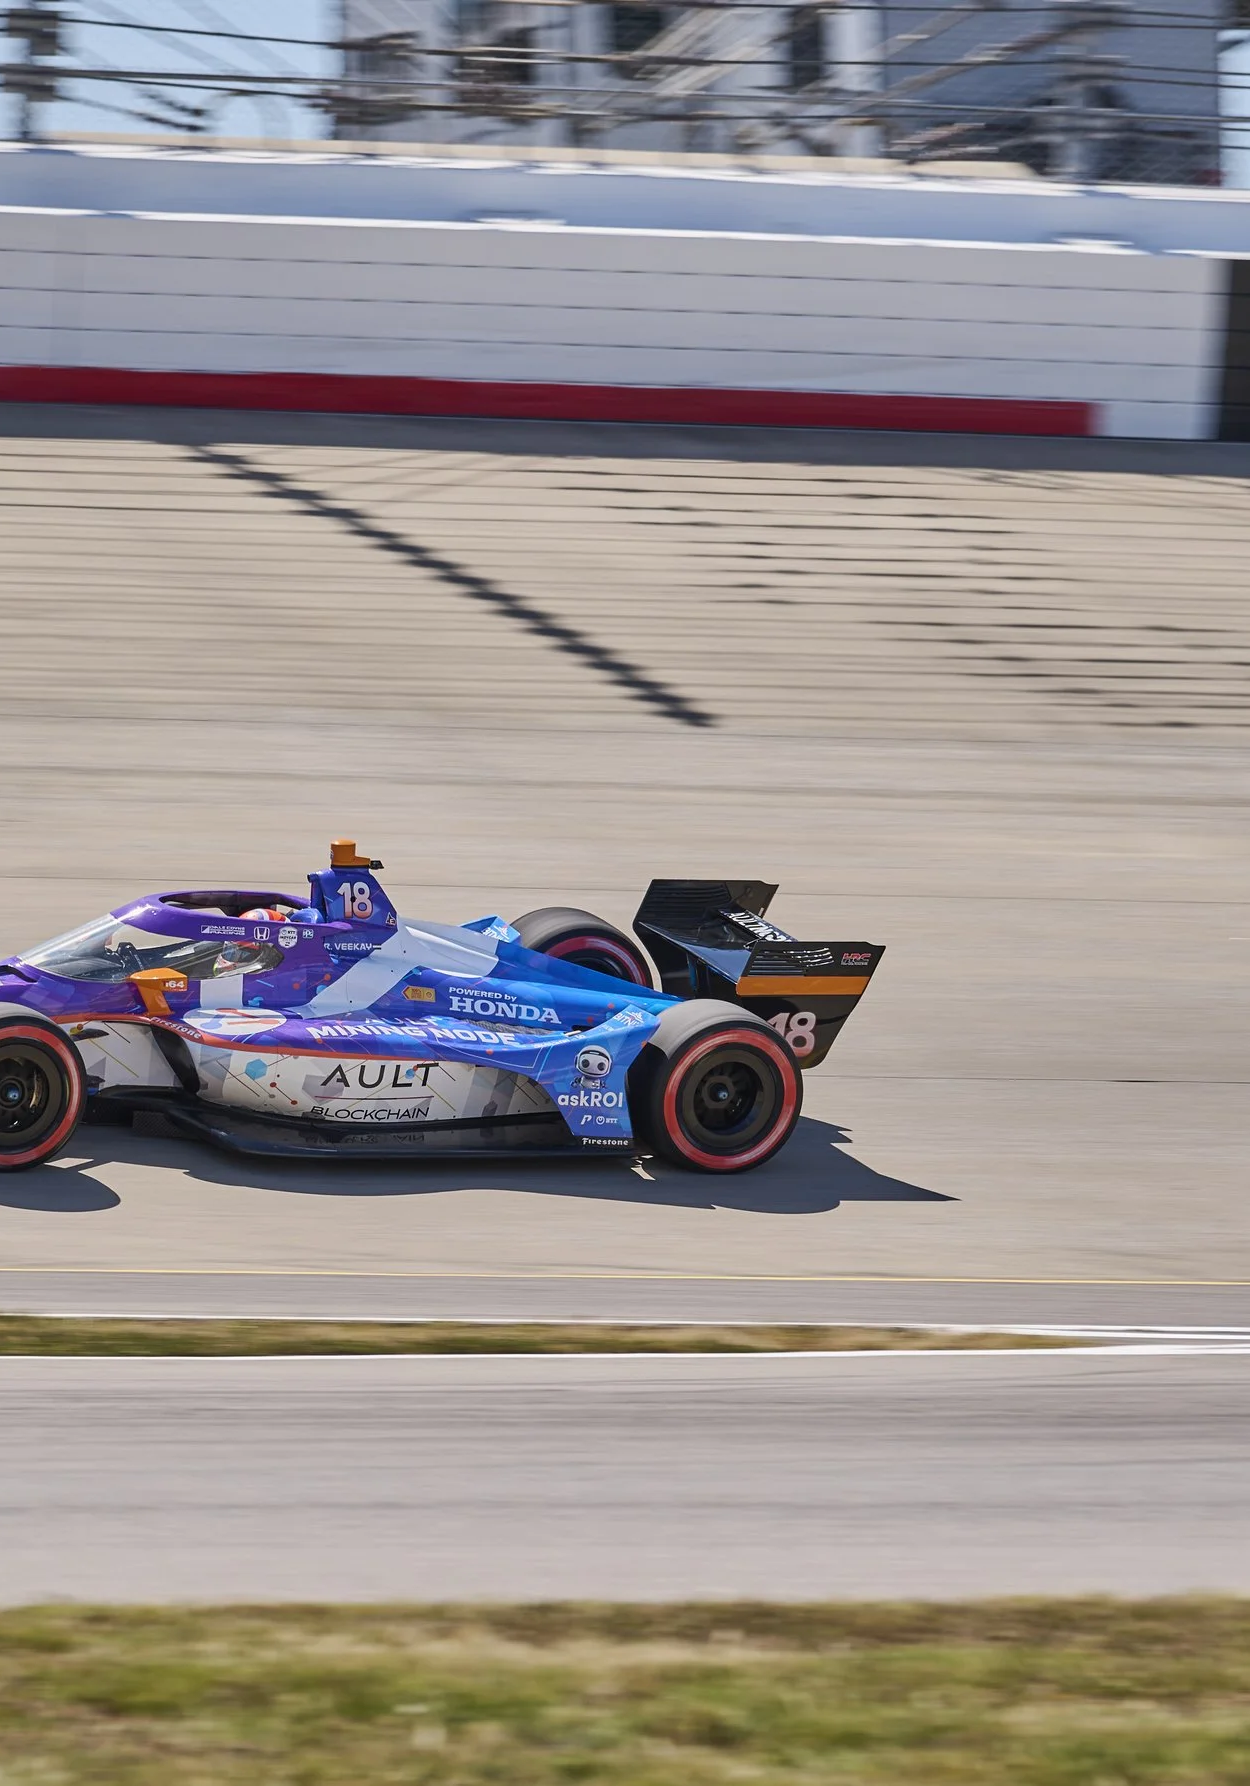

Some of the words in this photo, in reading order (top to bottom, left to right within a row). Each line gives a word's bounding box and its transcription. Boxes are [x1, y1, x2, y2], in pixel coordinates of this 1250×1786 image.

[336, 881, 373, 919] 18
[334, 943, 372, 951] VEEKAY
[449, 986, 502, 999] POWERED
[504, 994, 517, 1002] by
[449, 996, 562, 1024] HONDA
[150, 1017, 202, 1039] Firestone
[306, 1025, 428, 1040] MINING
[426, 1027, 521, 1046] NODE
[320, 1063, 440, 1088] AULT
[557, 1090, 624, 1108] askROI
[310, 1106, 430, 1120] BLOCKCHAIN
[582, 1137, 629, 1146] Firestone
